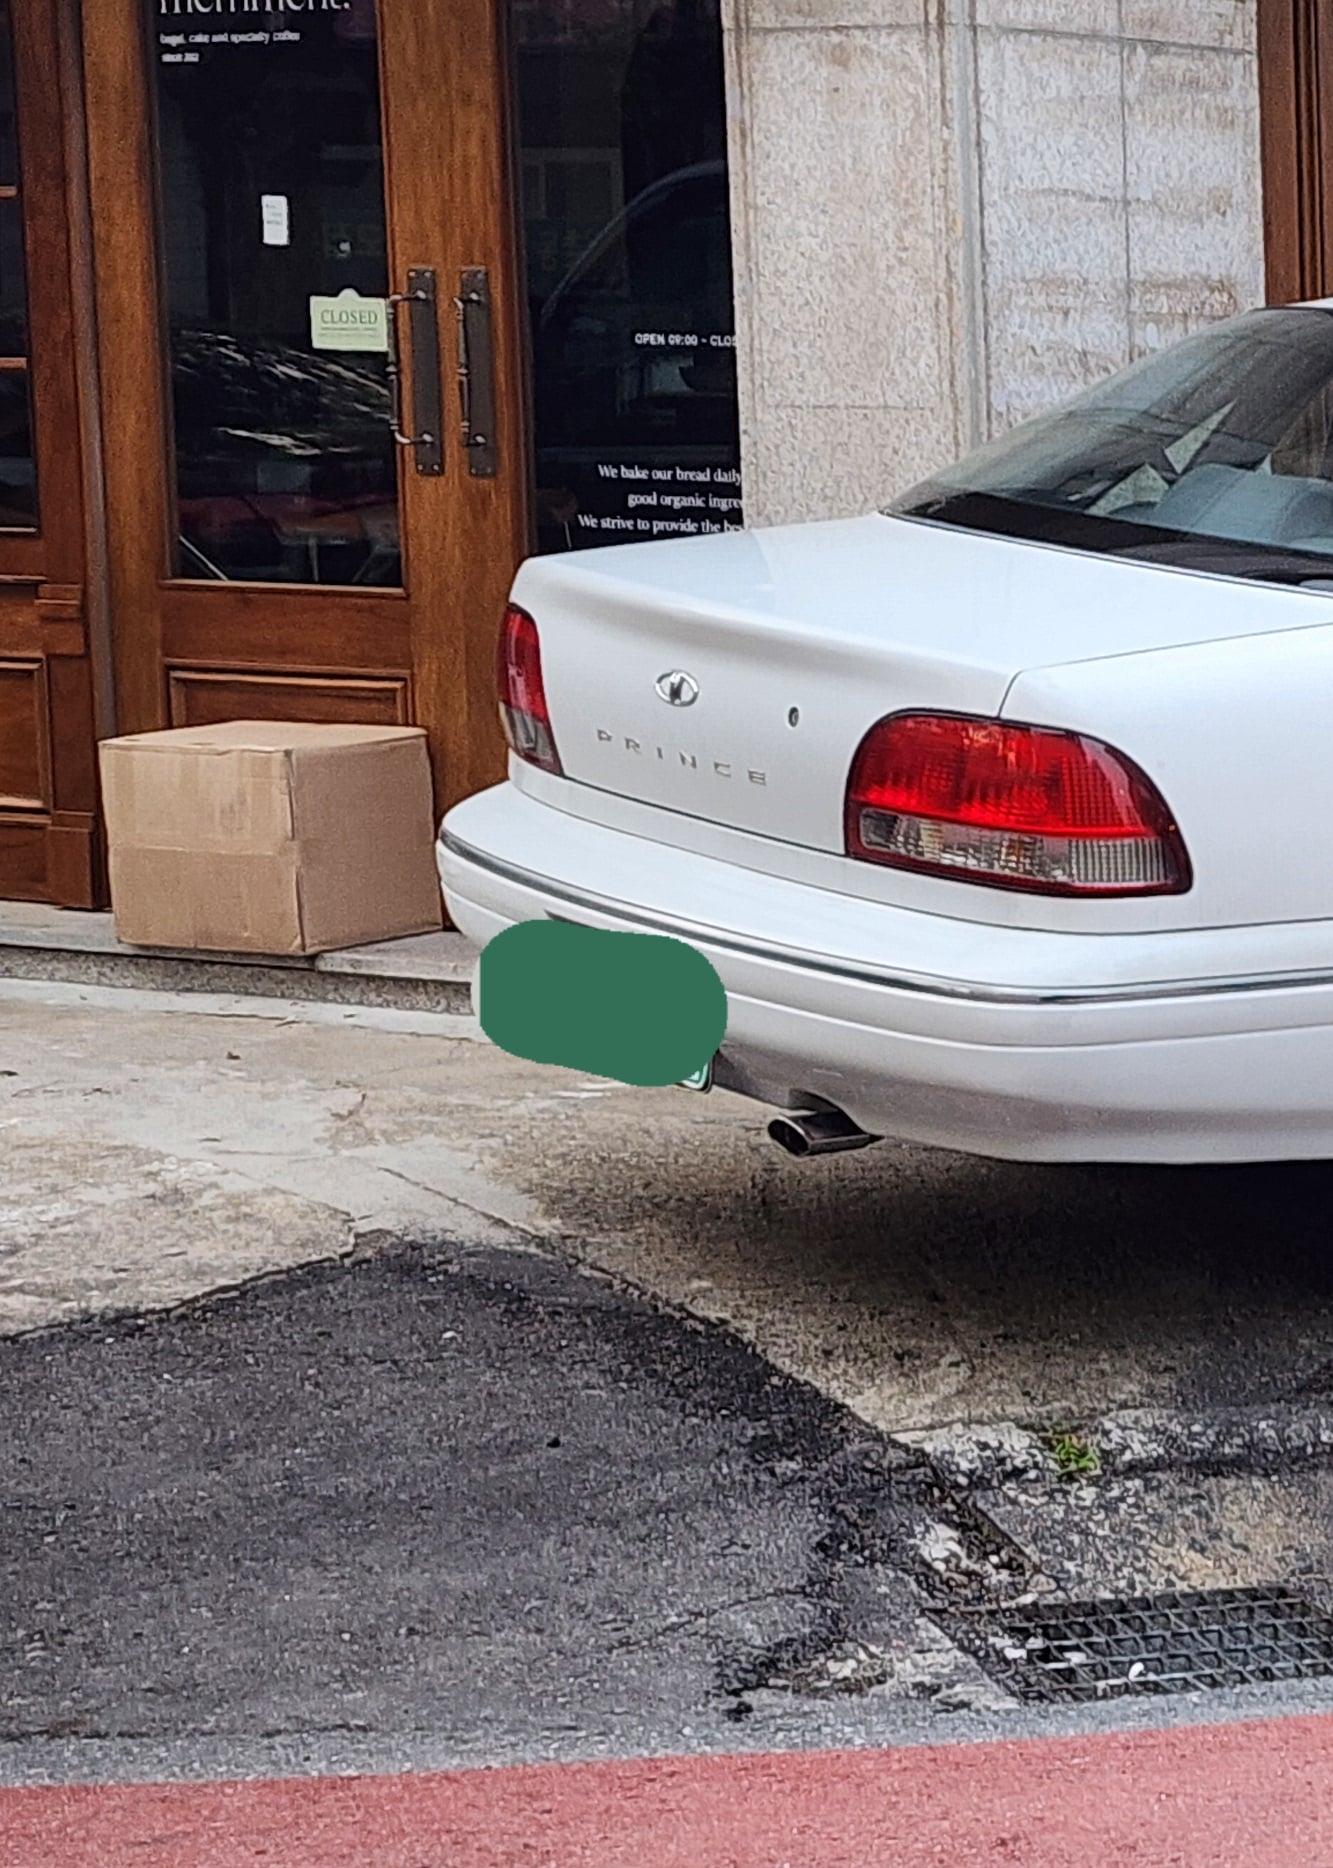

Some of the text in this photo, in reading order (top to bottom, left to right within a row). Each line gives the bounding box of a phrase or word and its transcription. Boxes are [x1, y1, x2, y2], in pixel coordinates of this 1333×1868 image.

[320, 309, 378, 325] CLOSED
[635, 333, 665, 345] OPEN
[598, 464, 618, 478] We
[620, 465, 649, 480] bake
[651, 469, 673, 481] our
[676, 466, 711, 482] bread
[628, 492, 657, 508] good
[660, 493, 706, 509] organic
[577, 514, 745, 535] We strive to provide the bes
[596, 729, 767, 786] PRINCE
